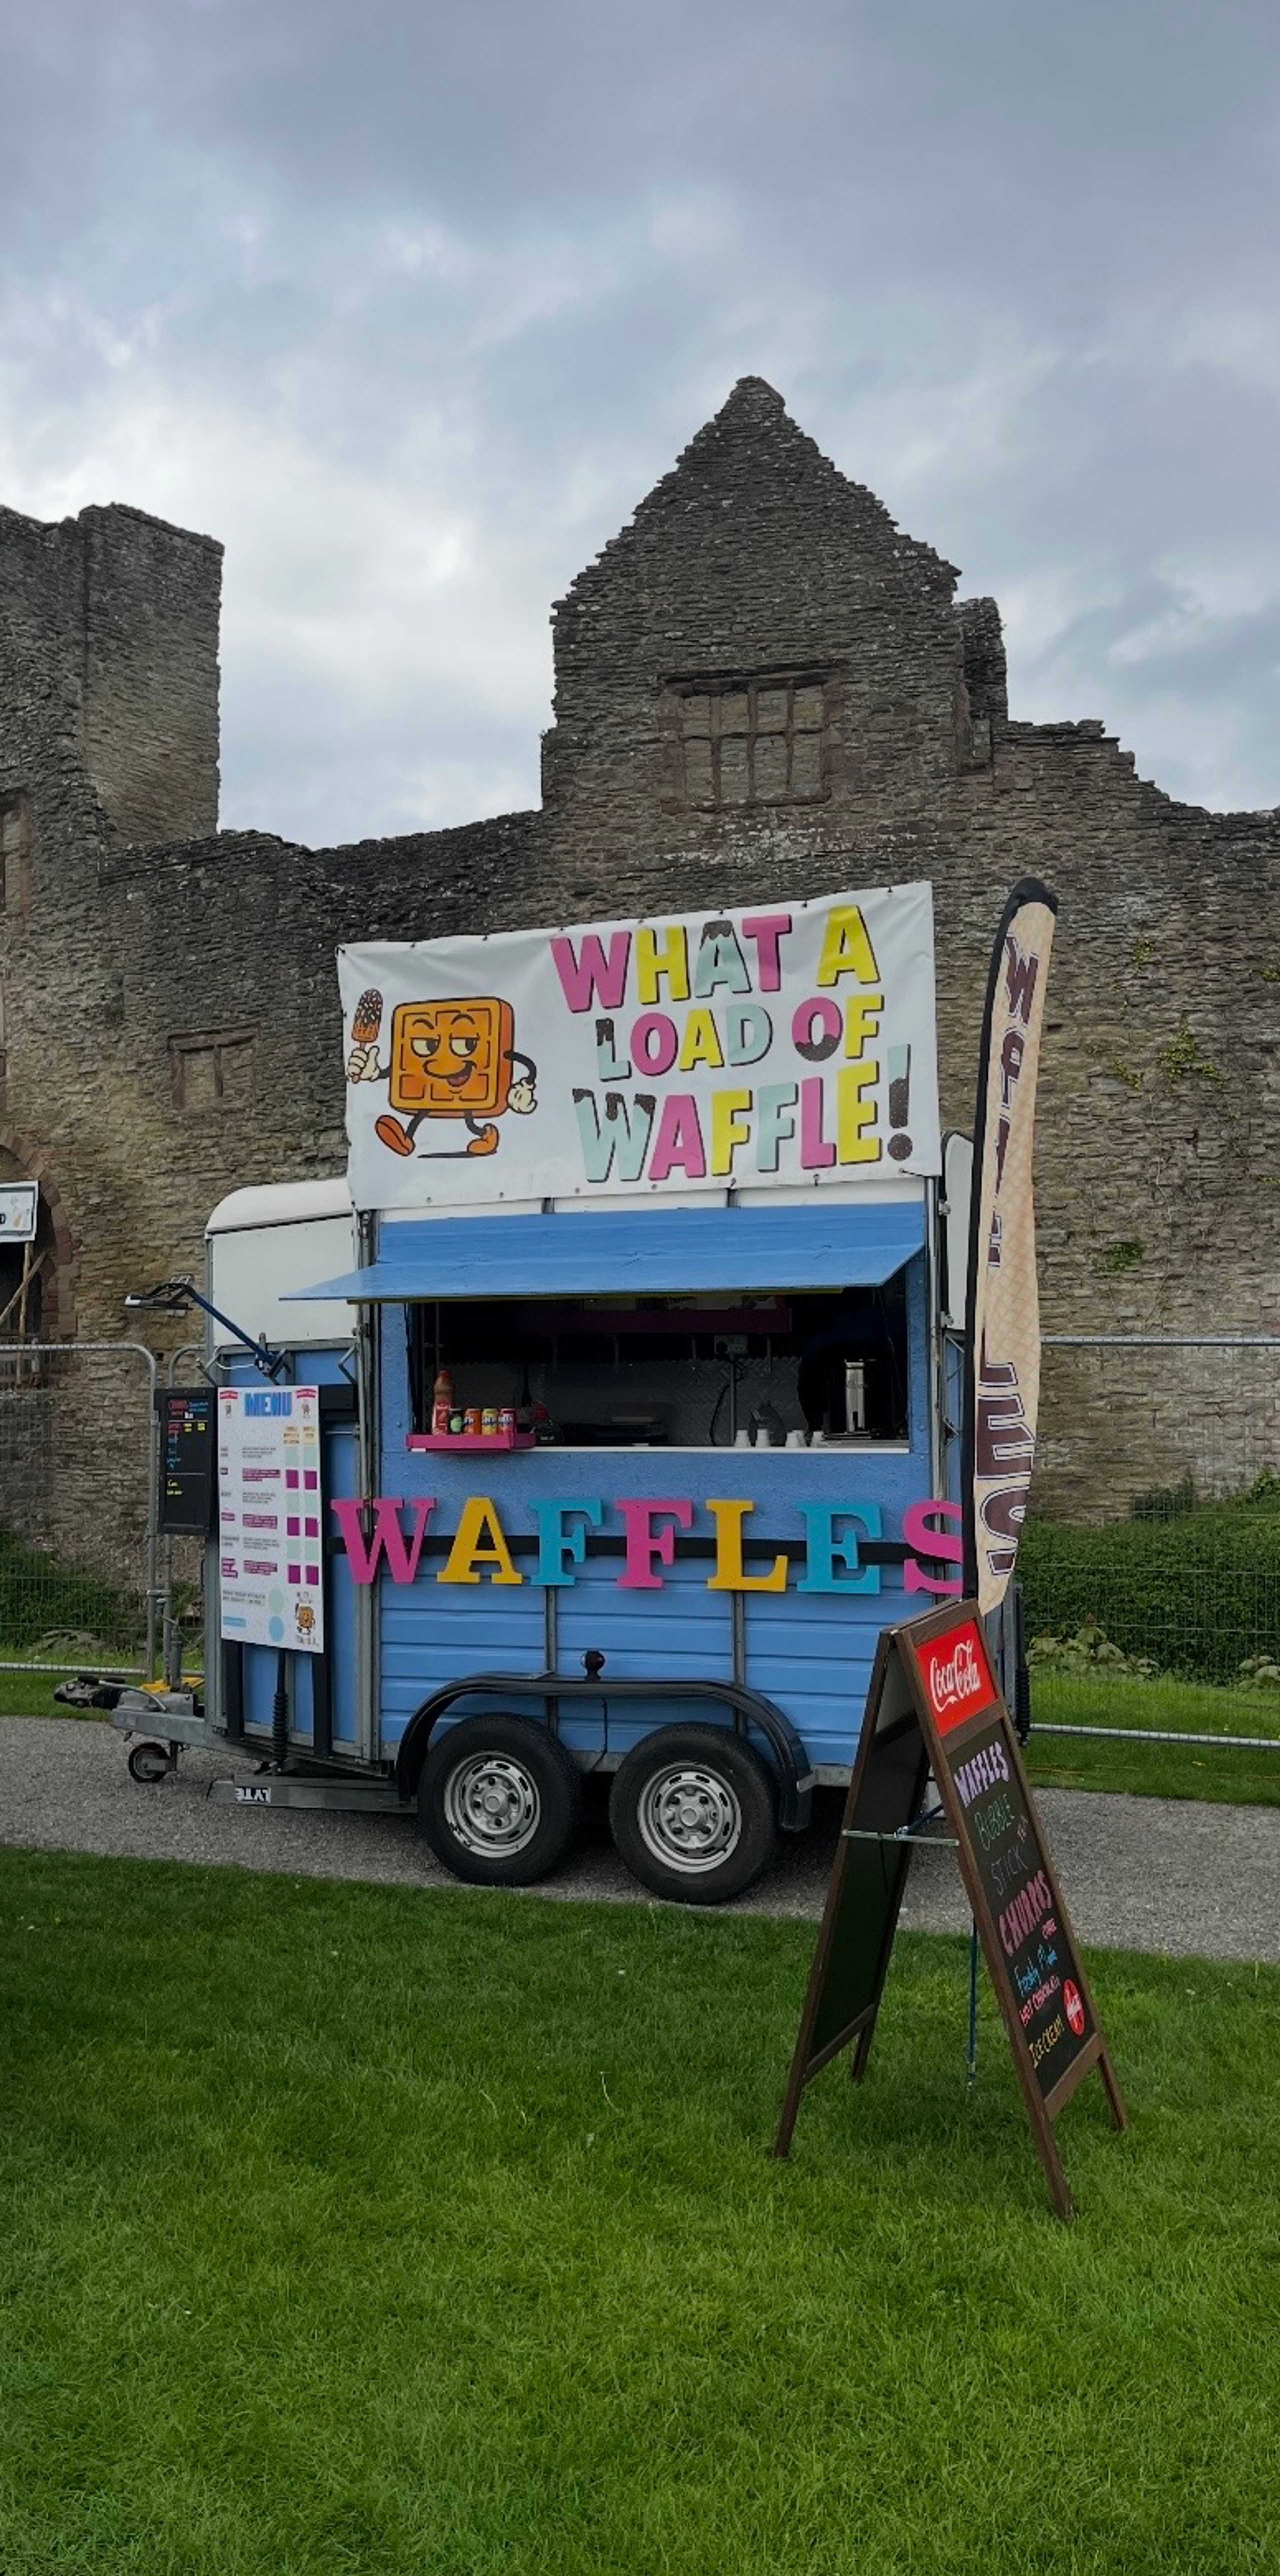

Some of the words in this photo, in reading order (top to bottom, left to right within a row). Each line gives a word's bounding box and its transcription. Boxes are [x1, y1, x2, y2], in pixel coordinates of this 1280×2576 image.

[550, 914, 792, 1013] WHAT
[816, 904, 880, 987] A
[596, 1003, 773, 1080] LOAD
[792, 994, 884, 1062] OF
[572, 1043, 913, 1182] WAFFLE!
[244, 1392, 292, 1416] MENU
[331, 1497, 963, 1595] WAFFLES
[235, 1787, 271, 1803] LYTE
[953, 1741, 1010, 1808] WAFFLES
[974, 1793, 1015, 1851] BUBBLE
[991, 1845, 1028, 1895] STICK
[999, 1870, 1053, 1956] CHURROS
